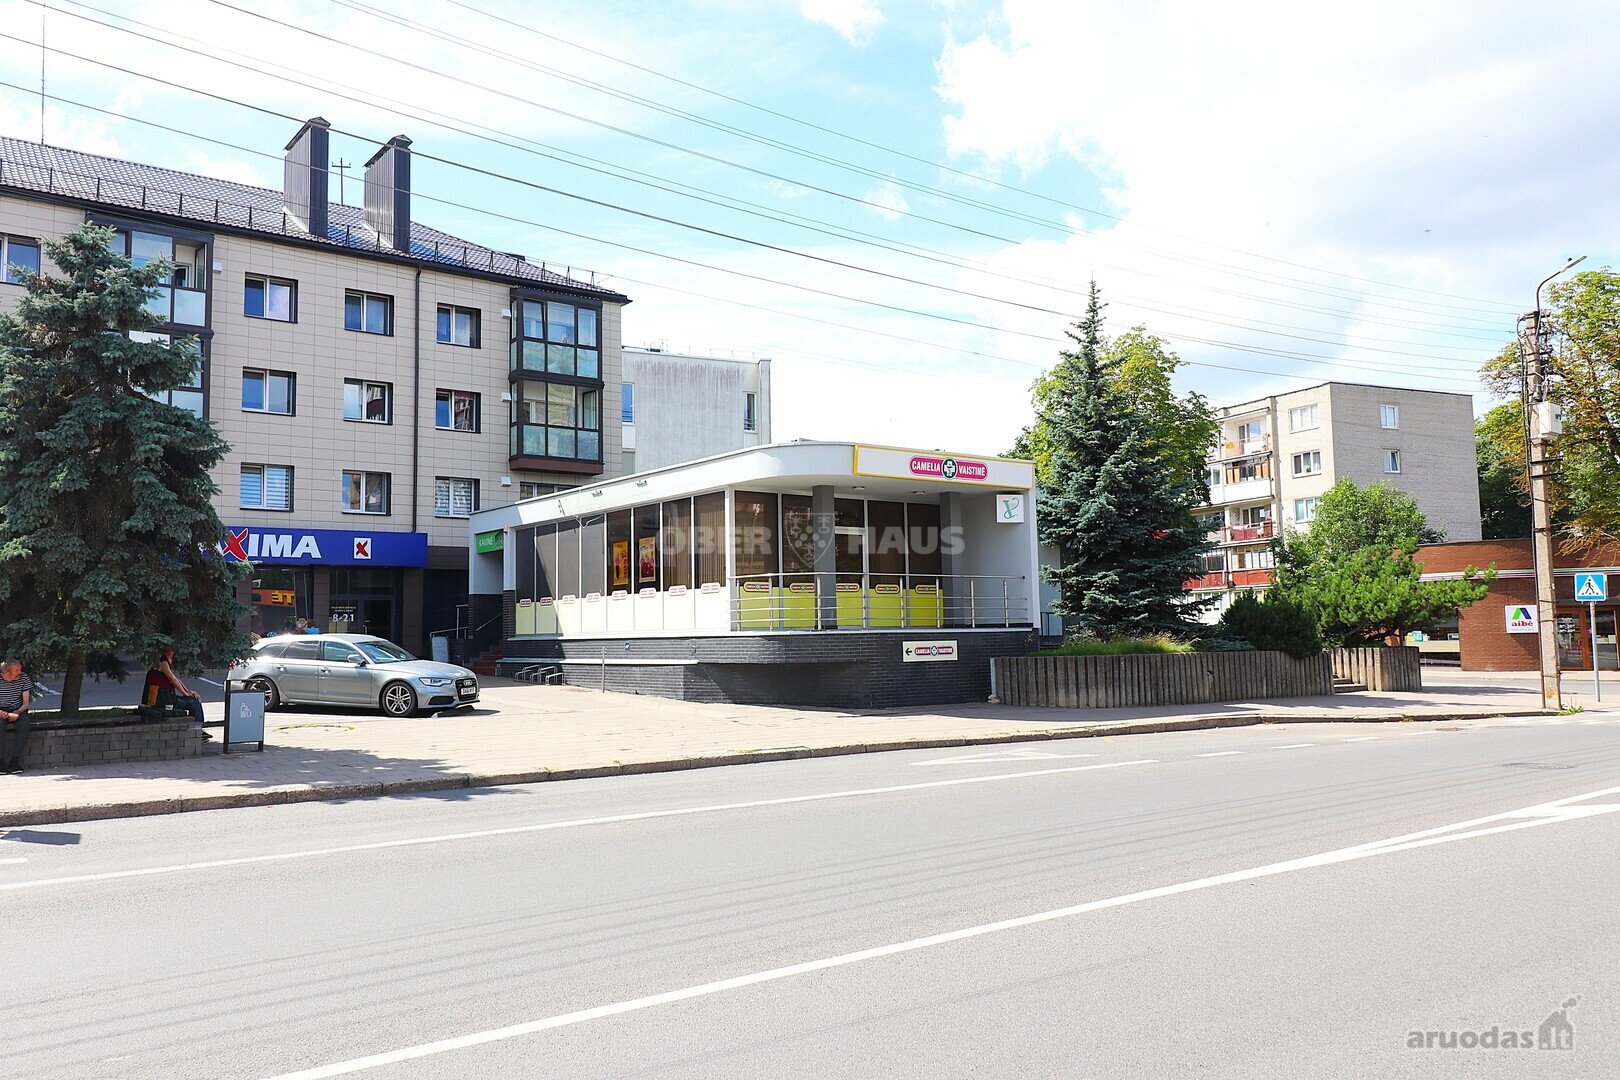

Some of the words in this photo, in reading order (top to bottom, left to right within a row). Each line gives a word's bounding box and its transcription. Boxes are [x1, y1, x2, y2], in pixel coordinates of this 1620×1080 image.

[912, 460, 941, 472] CAMELIA
[958, 464, 986, 476] VAISTINĖ
[332, 613, 354, 622] 8-21
